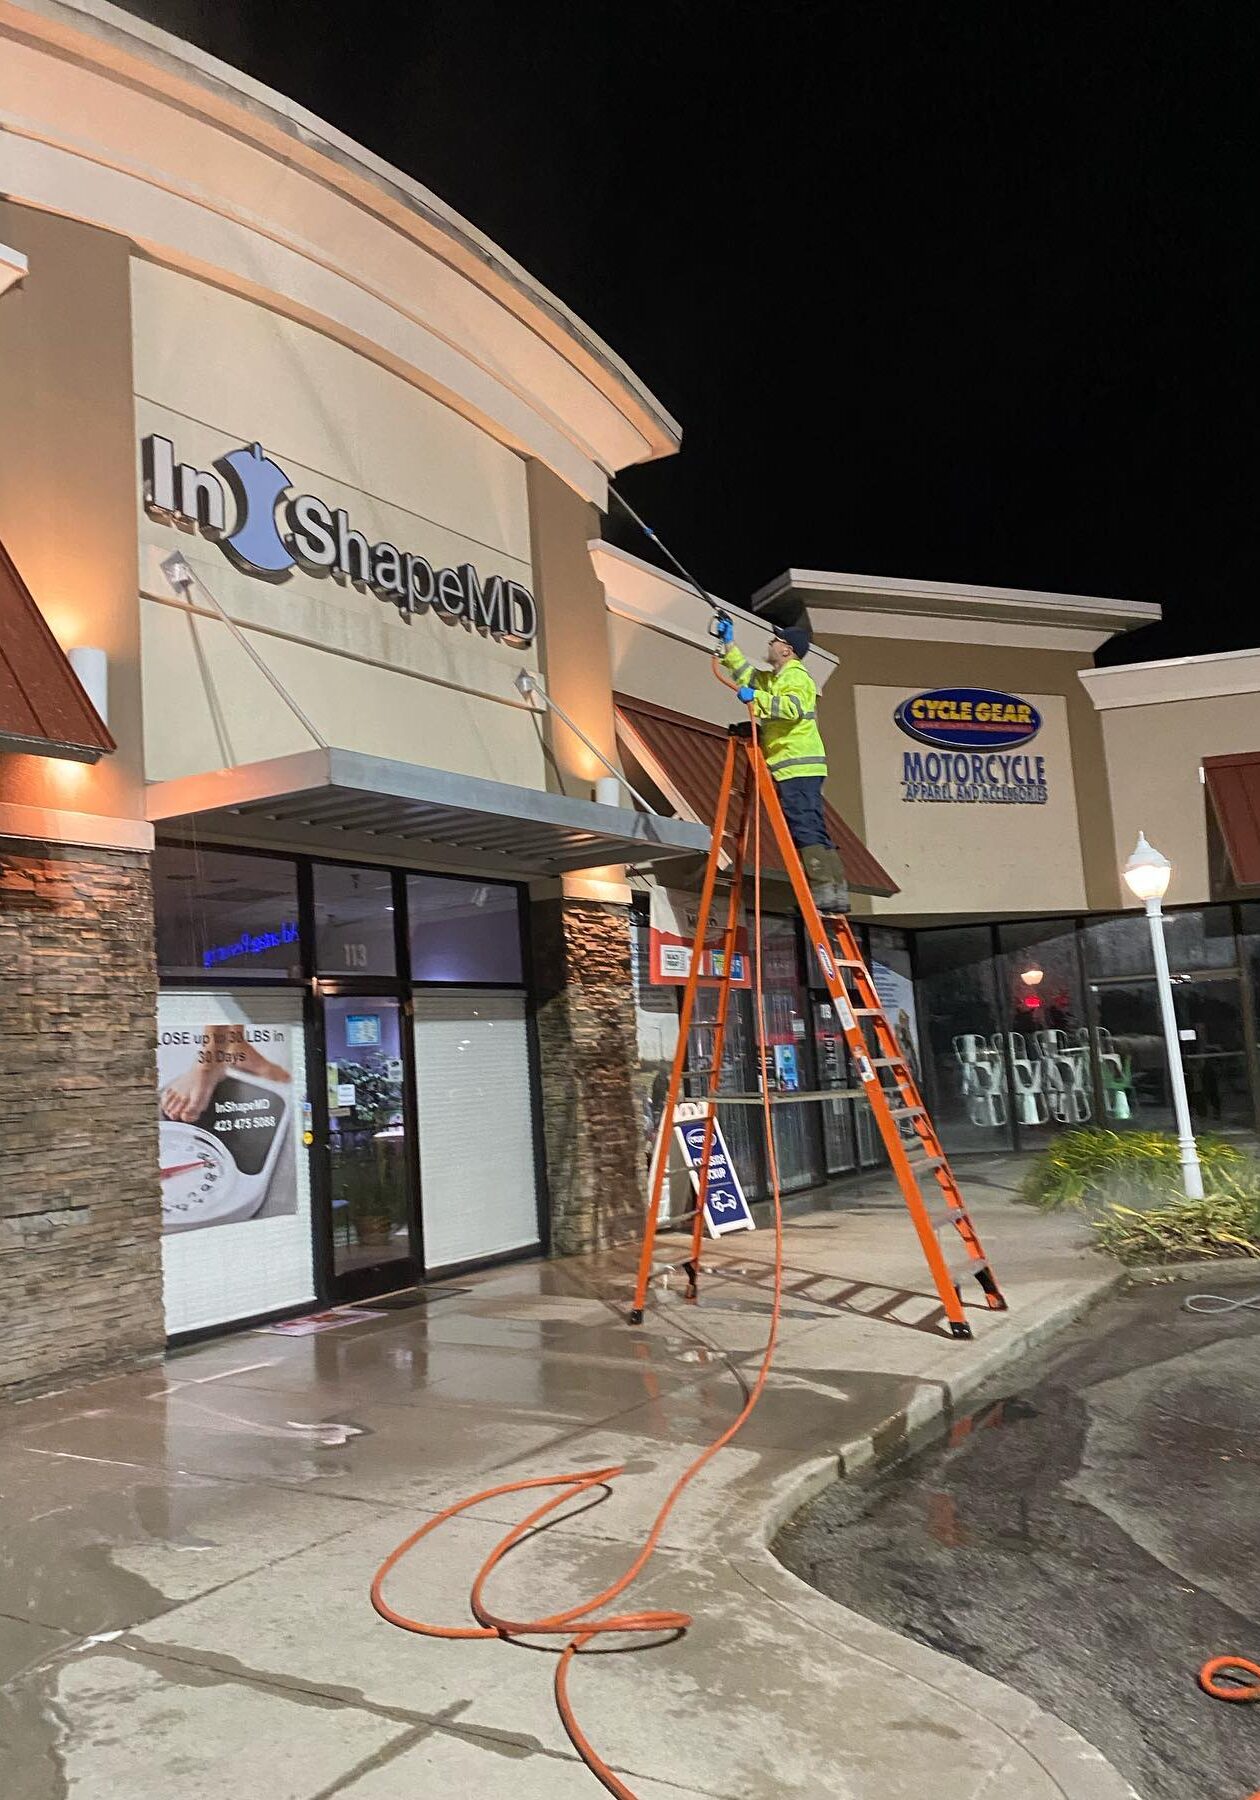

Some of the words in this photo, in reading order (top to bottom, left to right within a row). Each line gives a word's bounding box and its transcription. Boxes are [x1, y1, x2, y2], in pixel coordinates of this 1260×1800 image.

[289, 494, 537, 645] ShapeMD
[911, 699, 973, 720] CYCLE
[975, 702, 1033, 724] GEAR
[903, 752, 1047, 784] MOTORCYCLE
[905, 783, 953, 801] APPAREL
[956, 784, 979, 802] AND
[980, 785, 1048, 803] ACCESSORIES
[343, 943, 367, 967] 113
[194, 1034, 210, 1047] up
[246, 1029, 270, 1042] LBS
[273, 1030, 285, 1042] in
[198, 1050, 213, 1064] 30
[215, 1050, 247, 1065] Days
[214, 1098, 270, 1114] InShapeMD
[213, 1119, 233, 1132] 423
